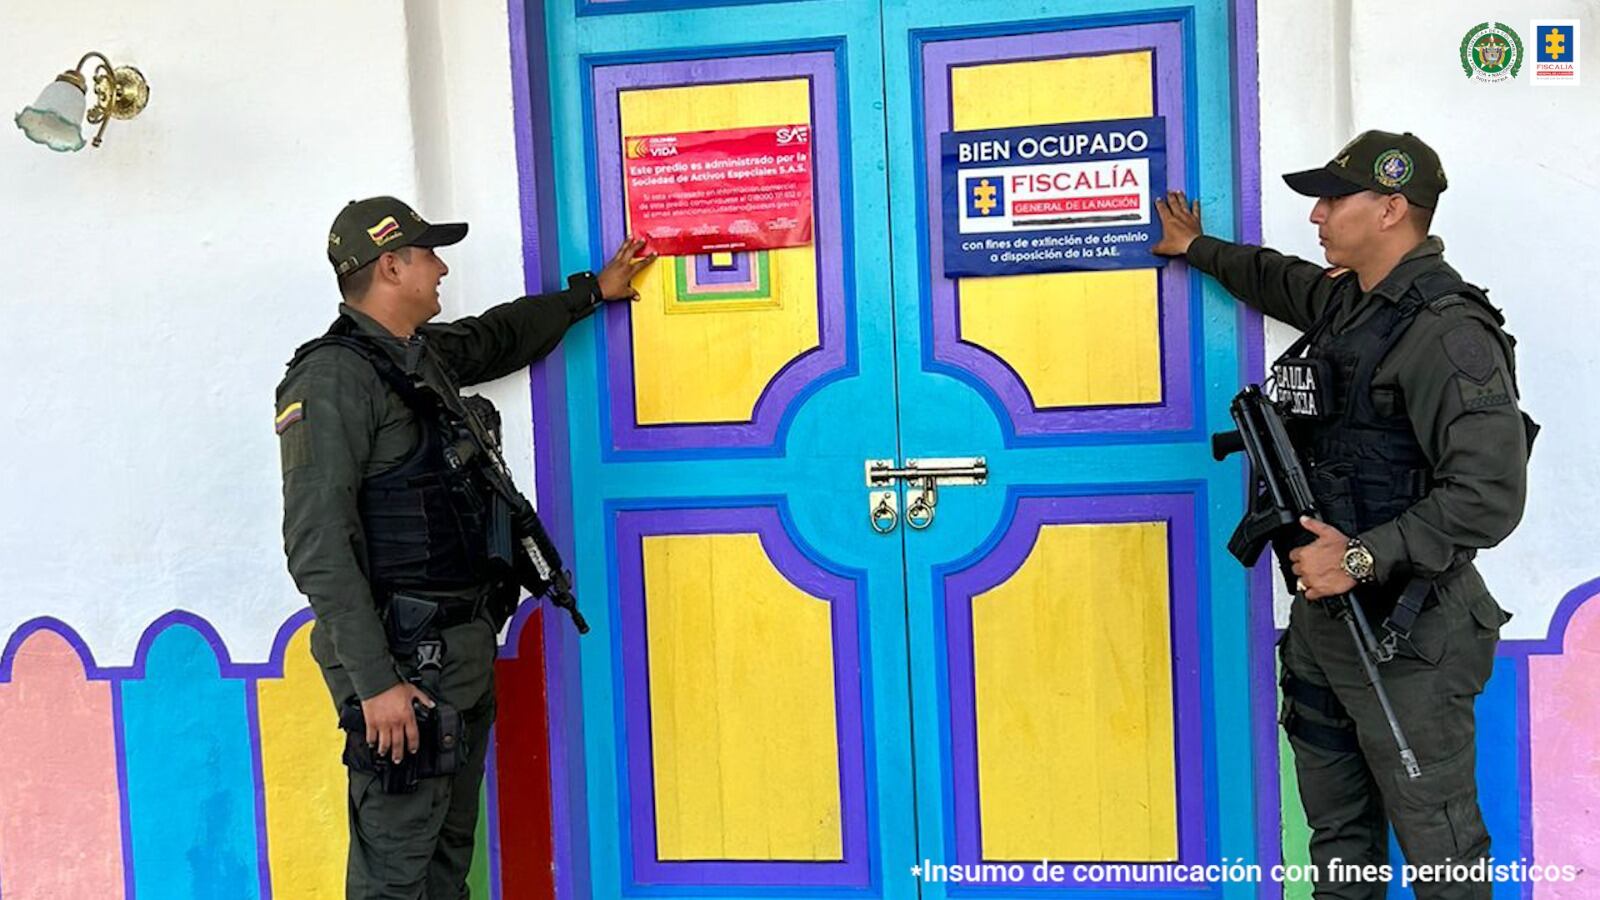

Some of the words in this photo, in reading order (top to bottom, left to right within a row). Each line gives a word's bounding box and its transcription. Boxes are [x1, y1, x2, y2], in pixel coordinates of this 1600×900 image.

[776, 127, 807, 144] SAE
[650, 146, 678, 157] VIDA
[959, 141, 1010, 163] BIEN
[1018, 130, 1149, 159] OCUPADO
[630, 165, 654, 177] Este
[654, 162, 689, 176] predio
[690, 162, 703, 171] es
[704, 155, 774, 169] administrado
[776, 154, 795, 165] por
[796, 152, 807, 162] la
[631, 175, 676, 187] Sociedad
[676, 174, 690, 183] de
[689, 171, 726, 182] Activos
[727, 167, 778, 180] Especiales
[1011, 165, 1139, 194] FISCALÍA
[1014, 202, 1063, 214] GENERAL
[1065, 200, 1080, 210] DE
[1082, 198, 1097, 209] LA
[1098, 196, 1138, 208] NACIÓN
[962, 240, 984, 251] con
[985, 238, 1012, 249] fines
[1013, 236, 1028, 248] de
[1031, 233, 1082, 247] extinción
[1084, 232, 1100, 244] de
[1103, 230, 1149, 243] dominio
[1000, 247, 1062, 264] disposición
[1064, 246, 1080, 259] de
[1082, 246, 1094, 258] la
[1096, 245, 1121, 257] SAE.
